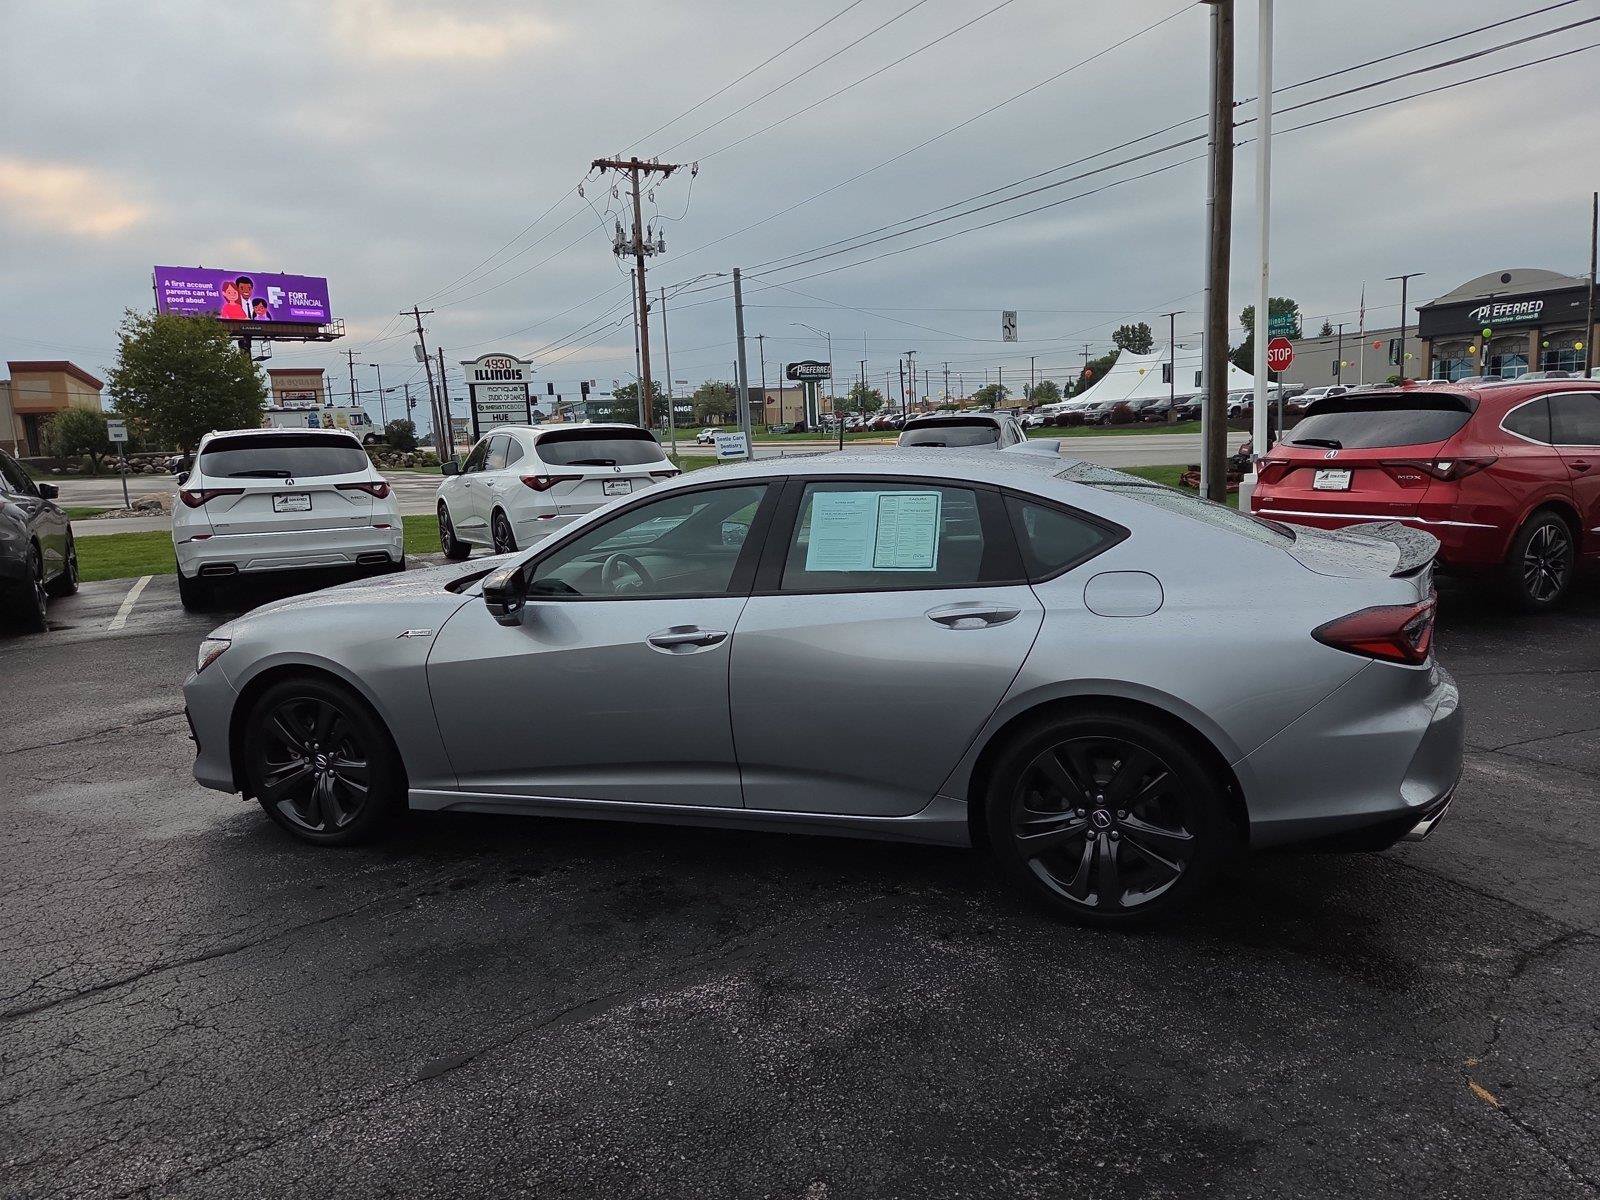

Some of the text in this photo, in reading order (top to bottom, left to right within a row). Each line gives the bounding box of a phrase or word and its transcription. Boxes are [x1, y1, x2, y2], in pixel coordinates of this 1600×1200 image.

[164, 279, 171, 287] A
[171, 280, 186, 288] first
[166, 296, 184, 304] good
[288, 291, 308, 300] FORT
[289, 299, 323, 307] FINANCIAL
[1267, 316, 1286, 326] llinois
[1481, 316, 1514, 324] Autmotive
[1267, 328, 1289, 336] awrence
[1268, 348, 1292, 362] STOP
[484, 359, 512, 369] 4930
[474, 369, 523, 381] ILLINOIS
[492, 413, 509, 421] HUE
